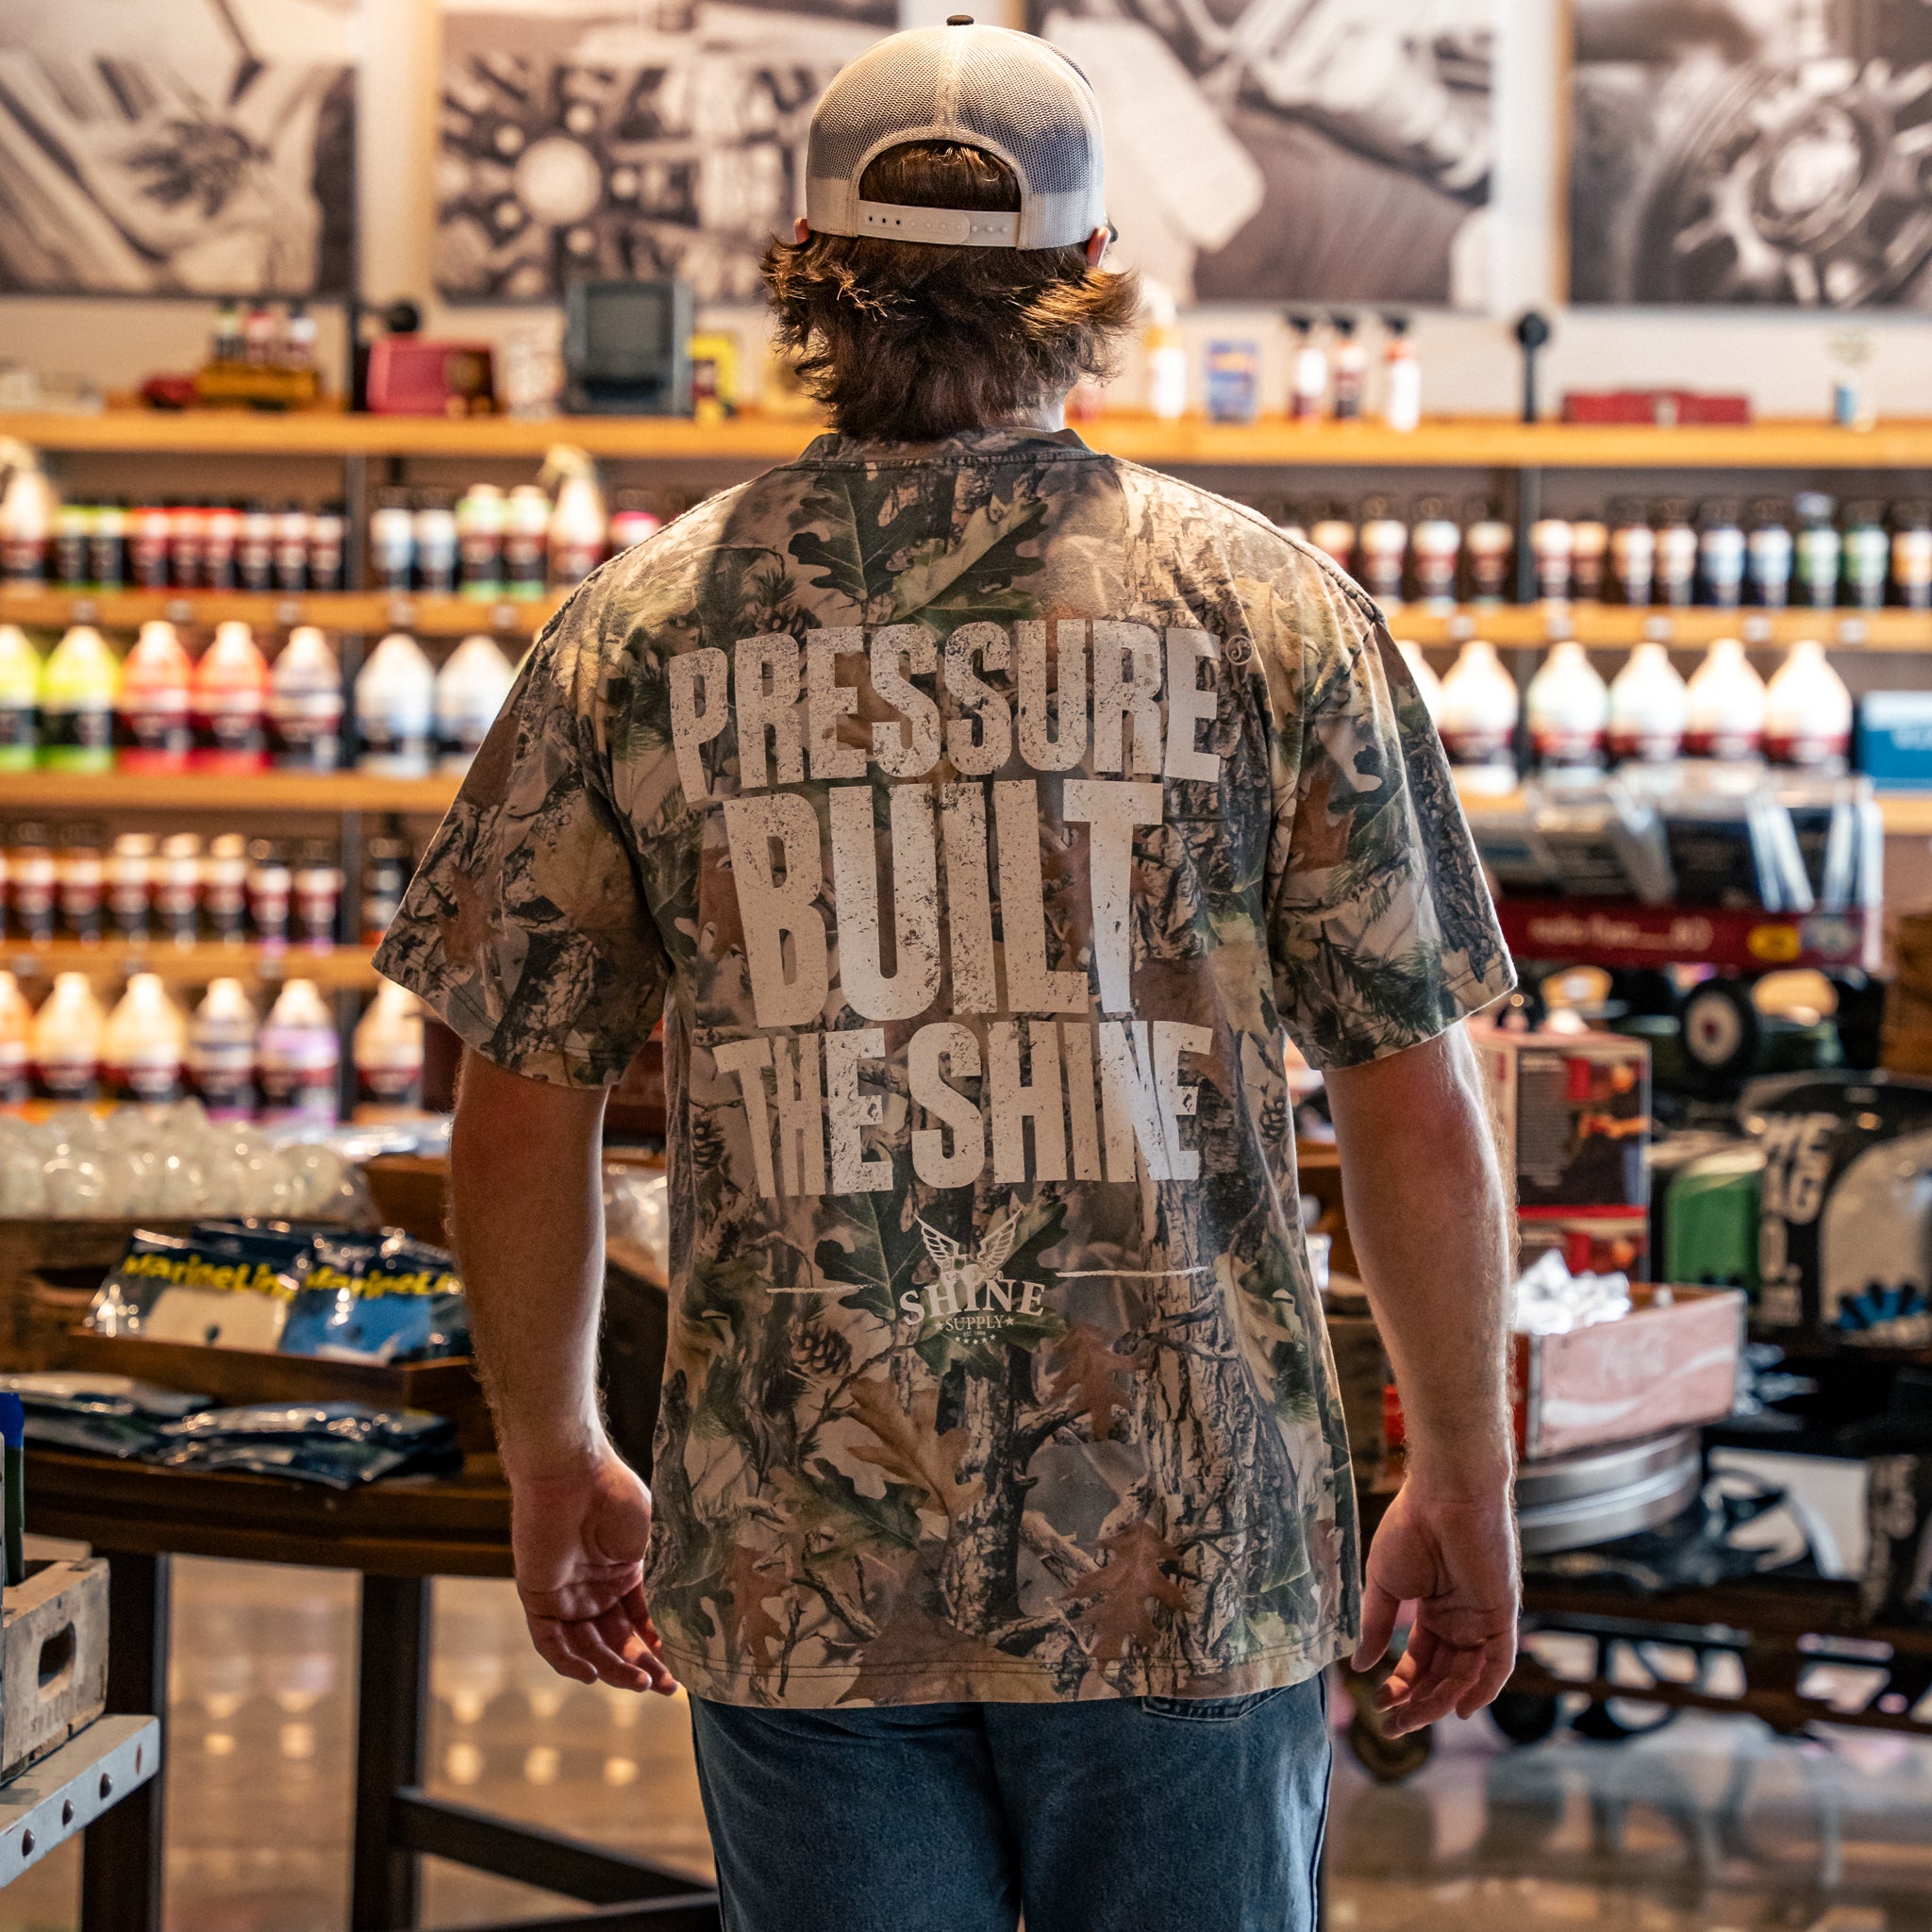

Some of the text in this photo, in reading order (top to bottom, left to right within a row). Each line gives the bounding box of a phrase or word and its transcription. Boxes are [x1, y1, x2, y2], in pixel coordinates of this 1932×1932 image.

[669, 619, 1221, 803] PRESSURE
[723, 778, 1163, 1028] BUILT
[712, 1021, 1213, 1198] THE SHINE
[899, 1270, 1045, 1325] SHINE
[945, 1315, 1006, 1332] SUPPLY
